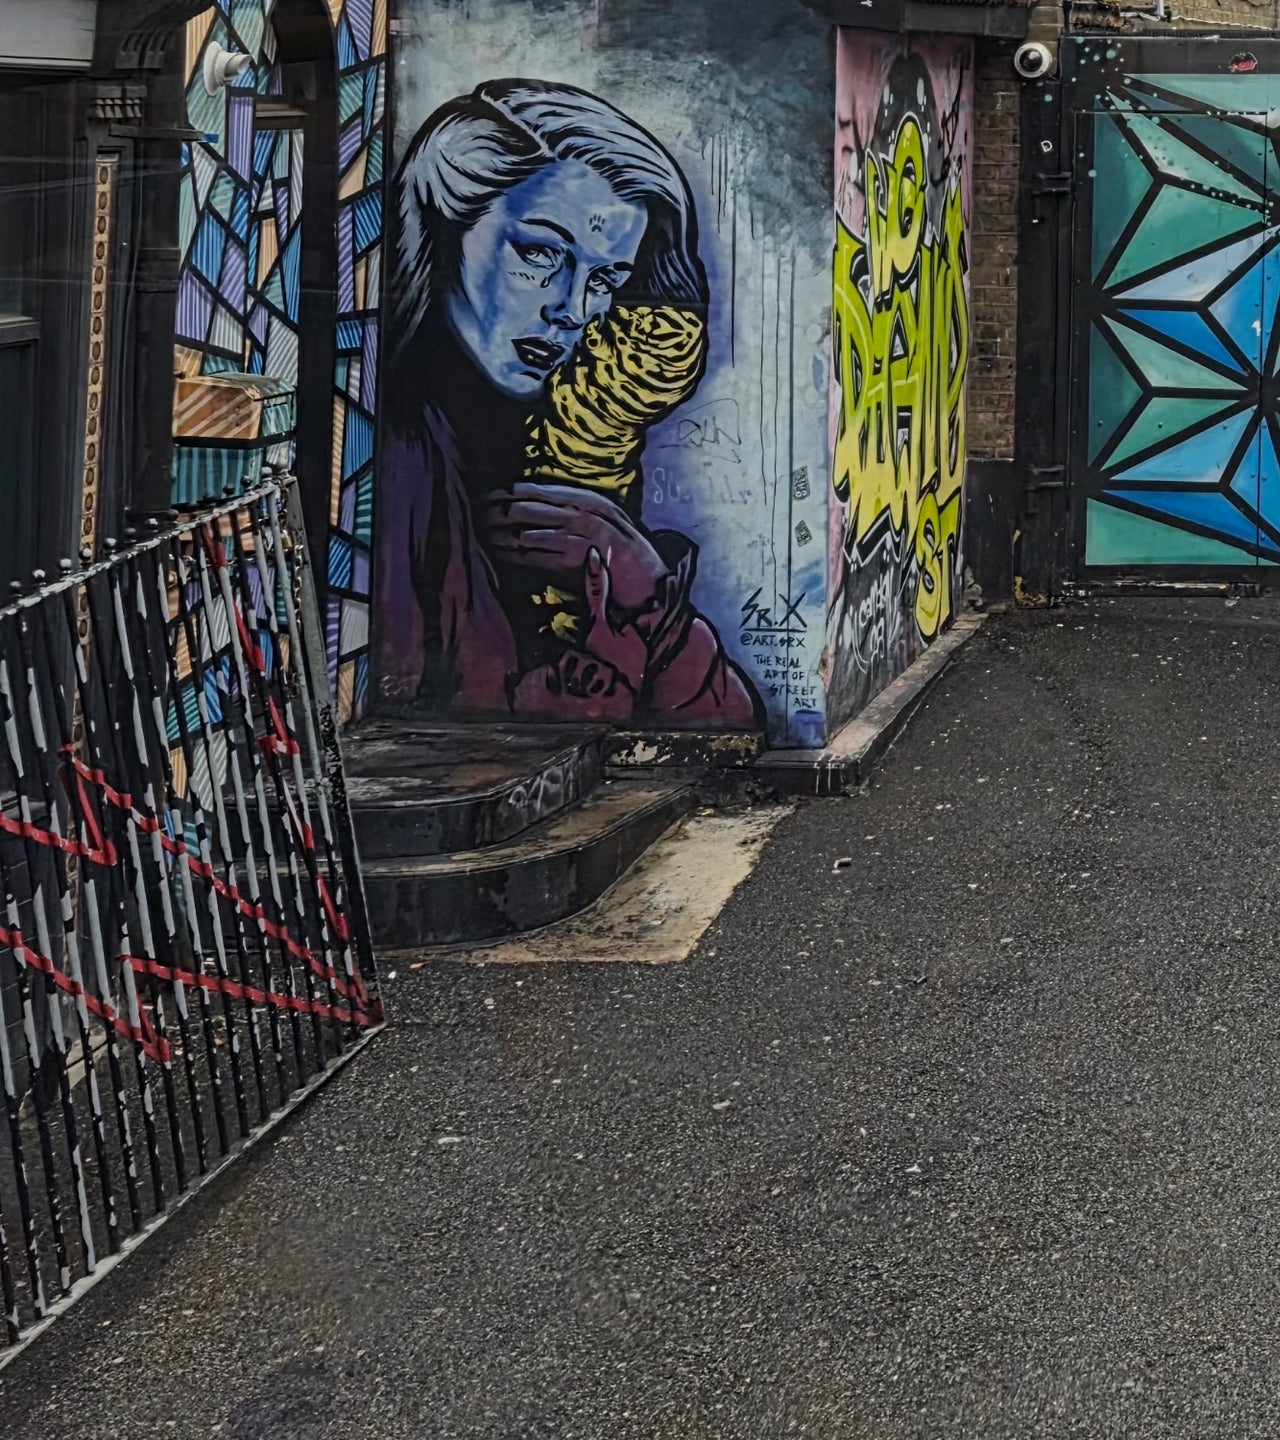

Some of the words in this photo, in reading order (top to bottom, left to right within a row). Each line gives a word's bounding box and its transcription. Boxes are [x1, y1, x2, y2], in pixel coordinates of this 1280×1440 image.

[753, 654, 772, 666] THE
[775, 656, 802, 669] REAL
[791, 671, 805, 680] OF
[768, 683, 817, 697] STREET
[793, 697, 817, 709] ART
